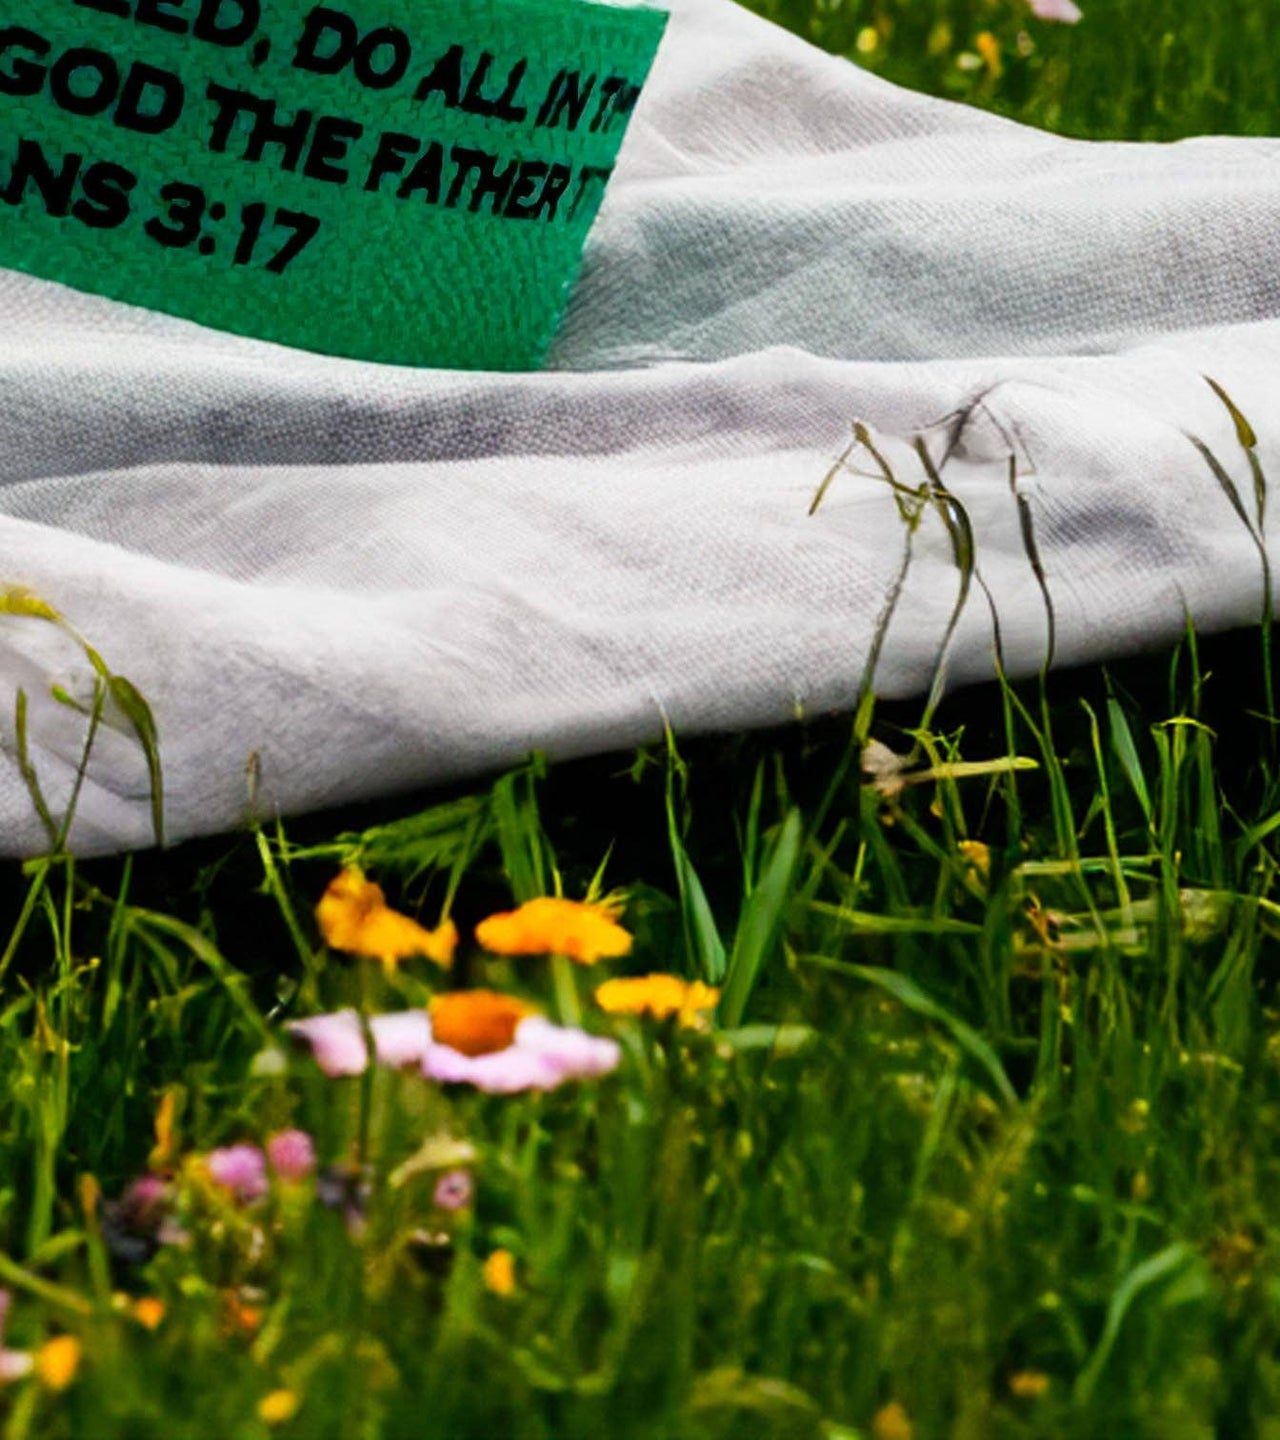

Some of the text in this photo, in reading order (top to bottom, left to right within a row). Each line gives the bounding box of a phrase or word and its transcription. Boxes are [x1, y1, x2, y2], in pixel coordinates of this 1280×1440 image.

[290, 4, 412, 91] DO
[412, 44, 528, 124] ALL
[534, 68, 597, 132] IN
[203, 76, 363, 186] THE
[362, 129, 572, 222] FATHER
[142, 178, 322, 275] 3:17
